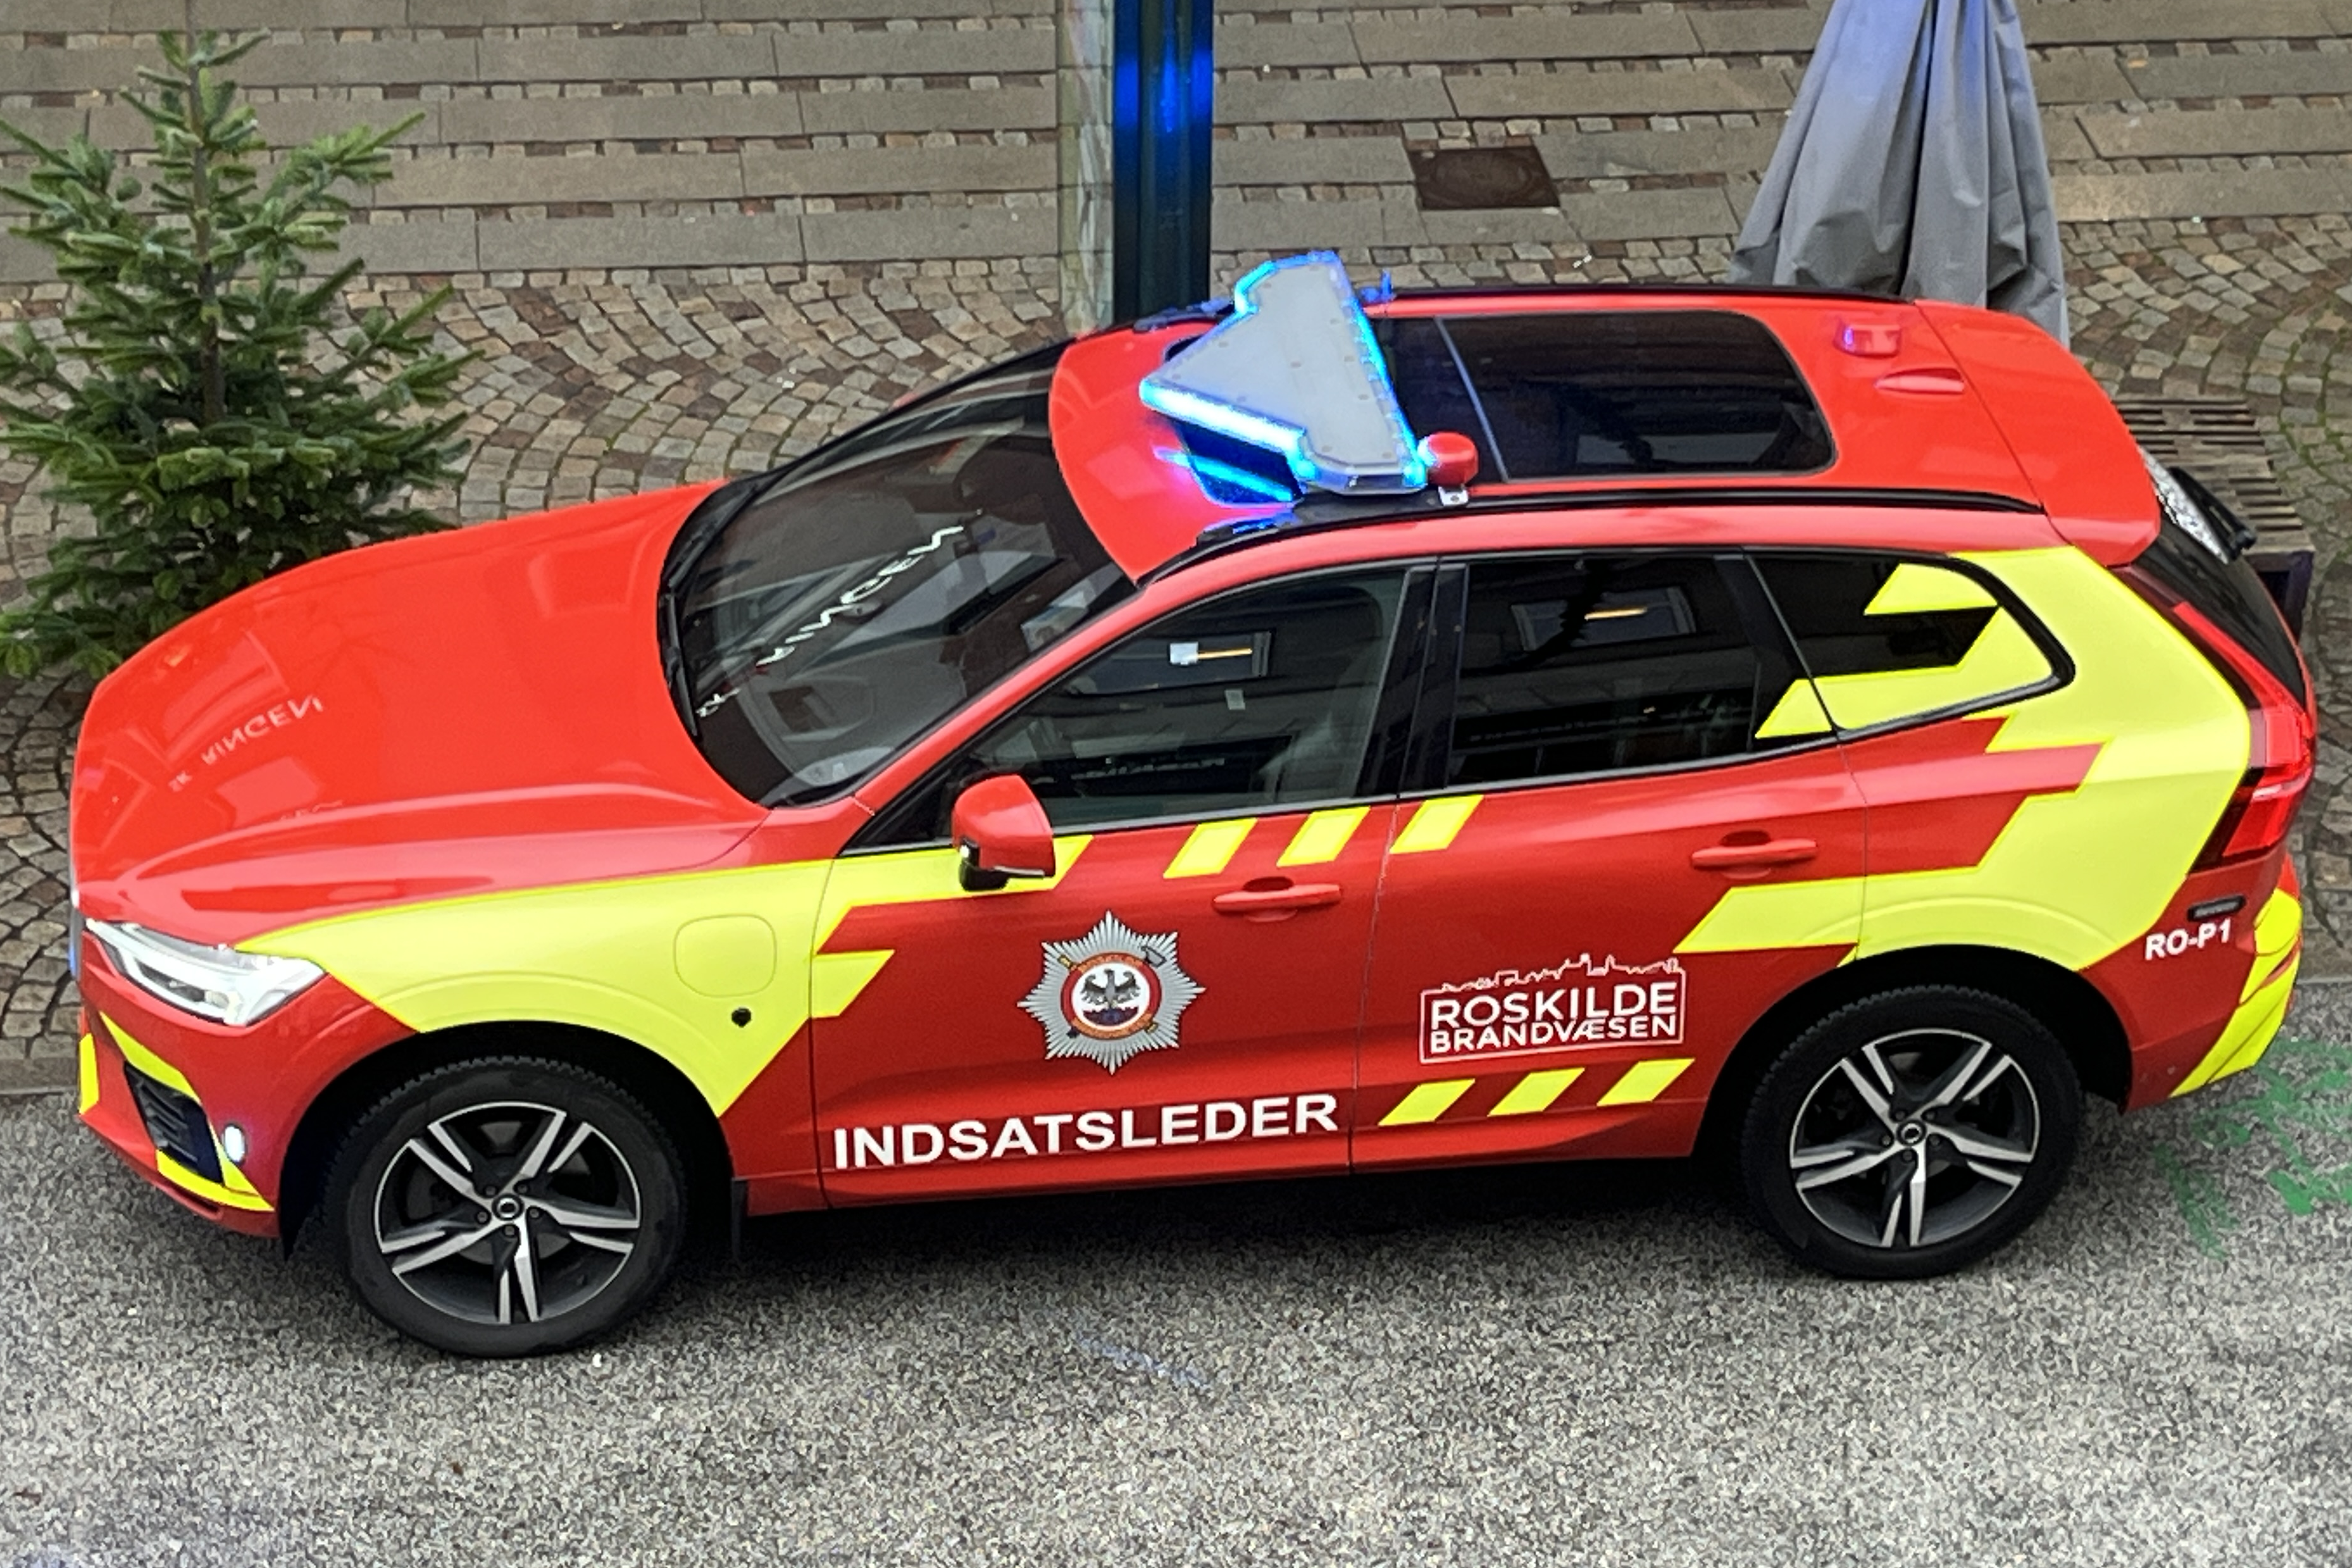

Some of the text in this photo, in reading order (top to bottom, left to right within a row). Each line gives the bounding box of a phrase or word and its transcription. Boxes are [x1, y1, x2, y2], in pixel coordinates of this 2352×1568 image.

[2144, 918, 2231, 961] RO-P1
[1430, 981, 1677, 1030] ROSKILDE
[1430, 1014, 1677, 1055] BRANDVÆSEN
[833, 1093, 1339, 1170] INDSATSLEDER
